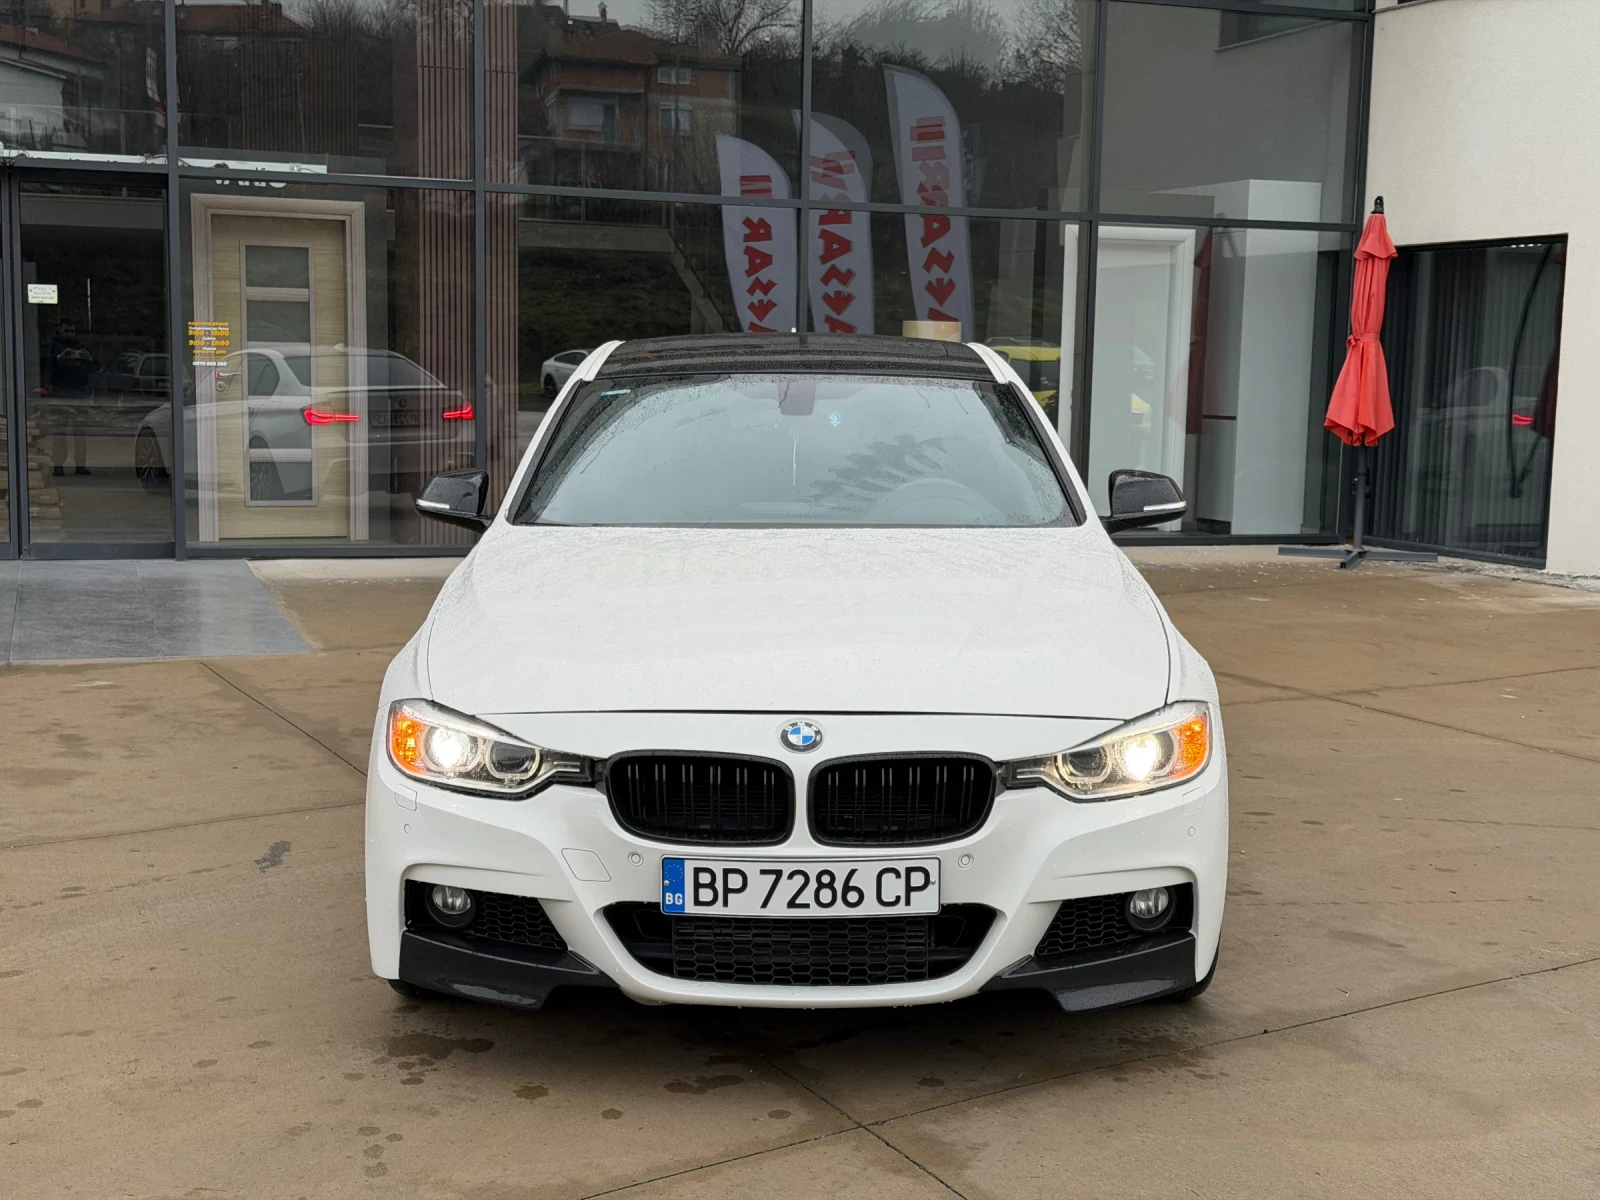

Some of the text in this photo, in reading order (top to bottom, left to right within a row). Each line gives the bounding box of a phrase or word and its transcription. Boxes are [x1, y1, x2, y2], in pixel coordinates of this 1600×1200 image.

[665, 892, 683, 905] BG
[693, 866, 930, 909] BP 7286 CP
